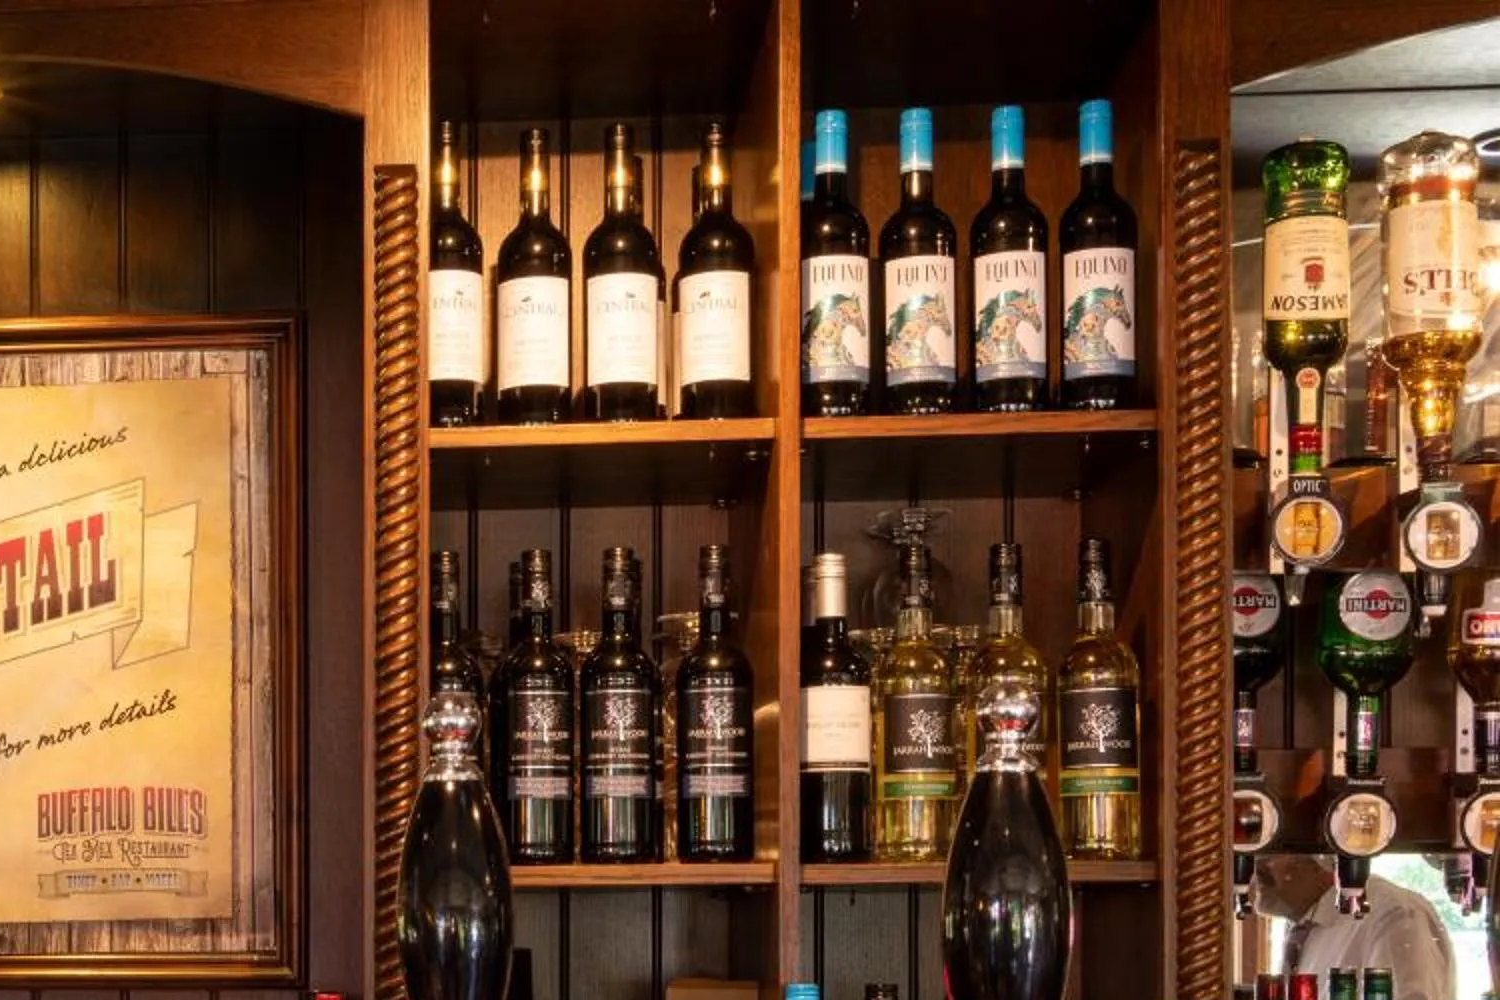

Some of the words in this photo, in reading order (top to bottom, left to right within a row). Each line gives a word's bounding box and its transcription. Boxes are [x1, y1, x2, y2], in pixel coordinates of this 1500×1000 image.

[18, 427, 129, 472] delicious
[1293, 479, 1321, 493] OPTIC
[1345, 596, 1408, 613] MARTINI
[36, 721, 92, 750] more
[99, 689, 177, 730] details
[38, 786, 132, 838] BUFFALO
